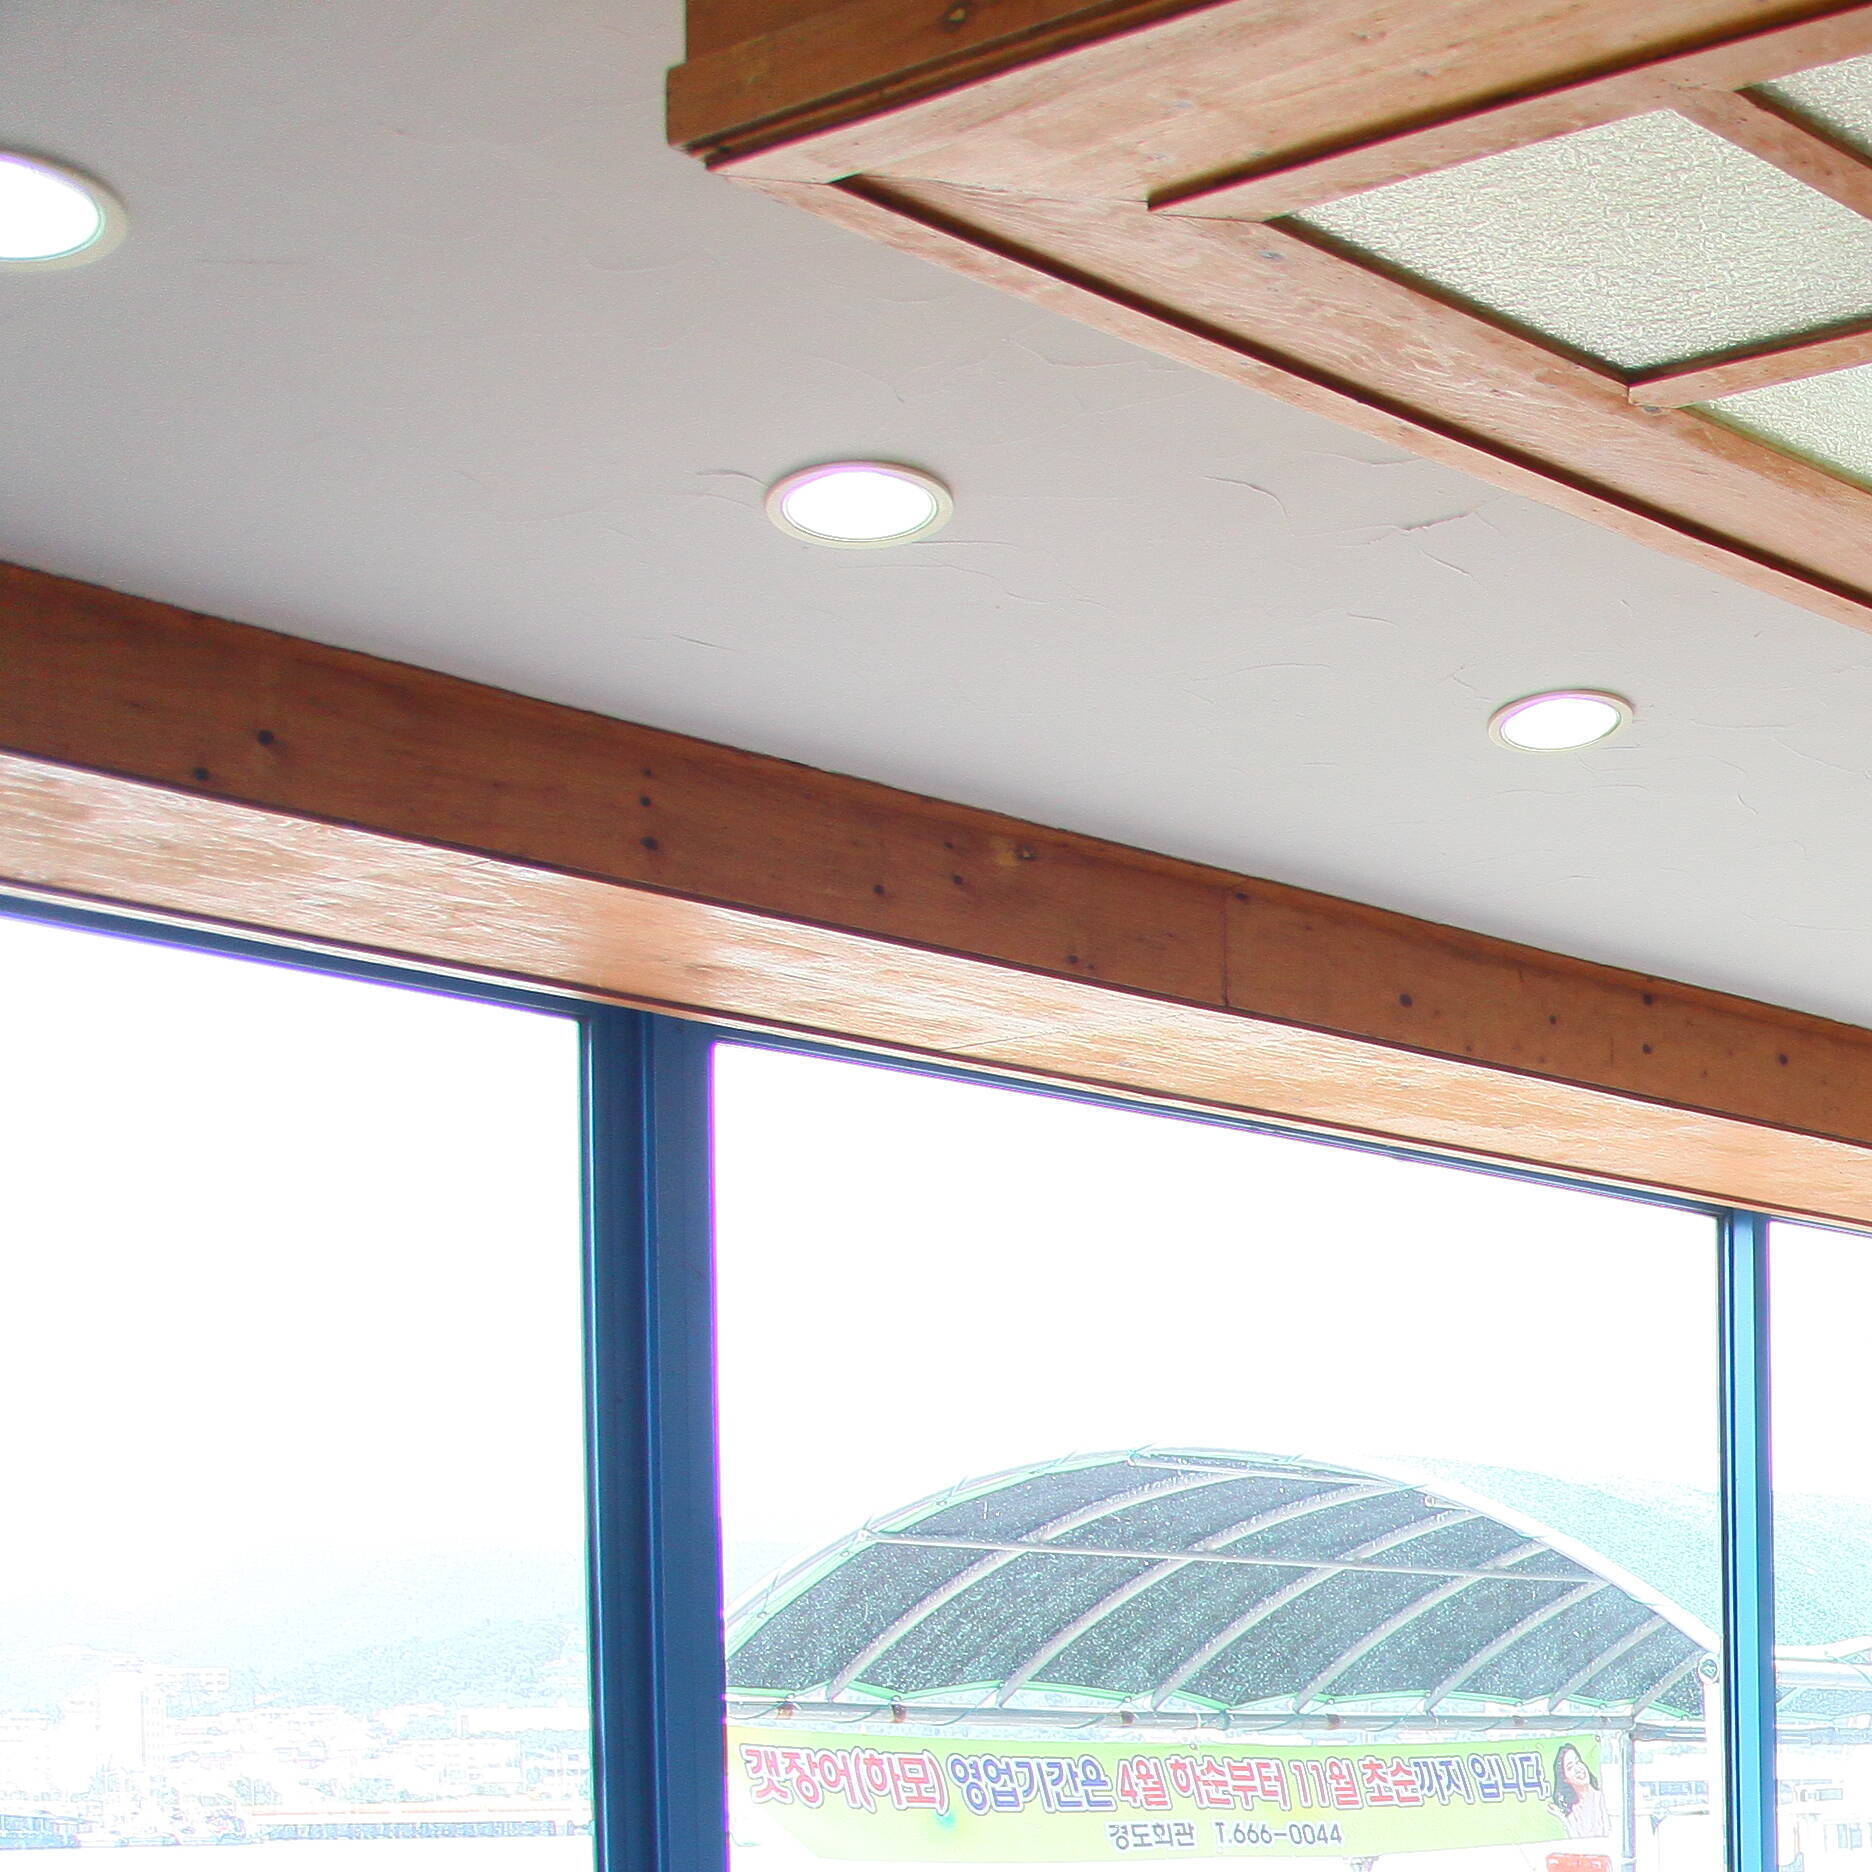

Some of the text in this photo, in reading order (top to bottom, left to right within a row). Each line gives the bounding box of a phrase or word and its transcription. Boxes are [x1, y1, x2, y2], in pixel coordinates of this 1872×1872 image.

[744, 1747, 948, 1812] 갯장어(하모)
[950, 1756, 1113, 1812] 영업기간은
[1119, 1759, 1169, 1808] 4월
[1170, 1757, 1288, 1808] 하순부터
[1292, 1757, 1361, 1807] 11월
[1362, 1756, 1472, 1803] 초순까지
[1108, 1822, 1342, 1850] 경도회관 T.666-0044
